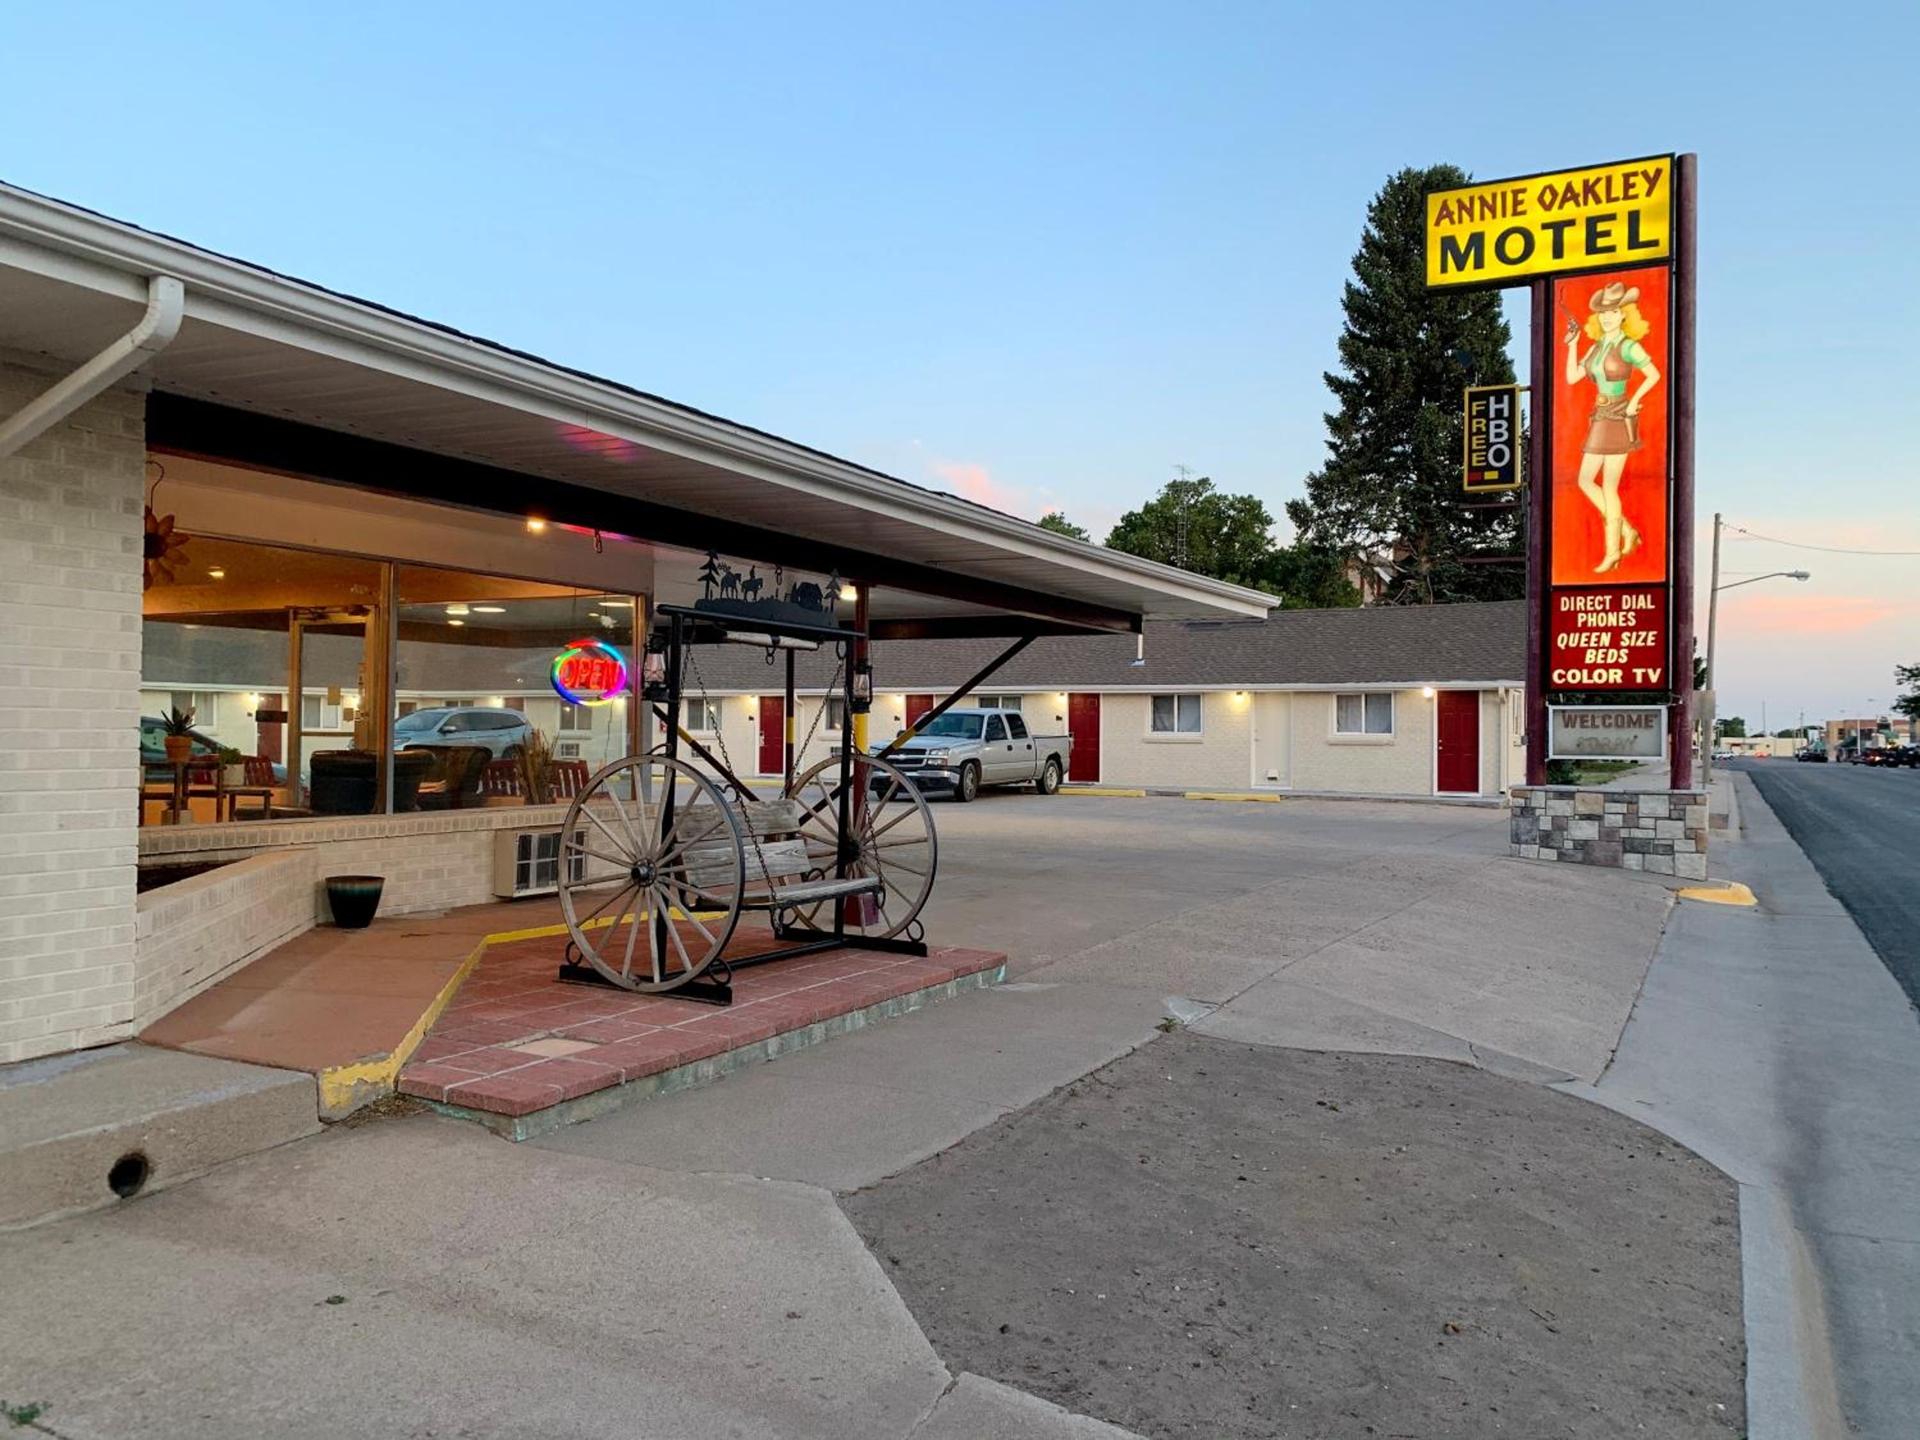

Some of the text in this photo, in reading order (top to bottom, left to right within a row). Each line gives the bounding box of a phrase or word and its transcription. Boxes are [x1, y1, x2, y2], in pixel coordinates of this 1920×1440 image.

[1434, 167, 1663, 227] ANNIE OAKLEY
[1440, 209, 1660, 274] MOTEL
[1471, 401, 1487, 467] FREE
[1487, 394, 1511, 468] HBO
[1560, 594, 1656, 611] DIRECT DIAL
[1577, 611, 1637, 627] PHONES
[1557, 631, 1658, 650] QUEEN SIZE
[1584, 648, 1629, 664] BEDS
[560, 657, 620, 690] OPEN
[1552, 668, 1662, 684] COLOR TV
[1562, 713, 1657, 729] WELCOME
